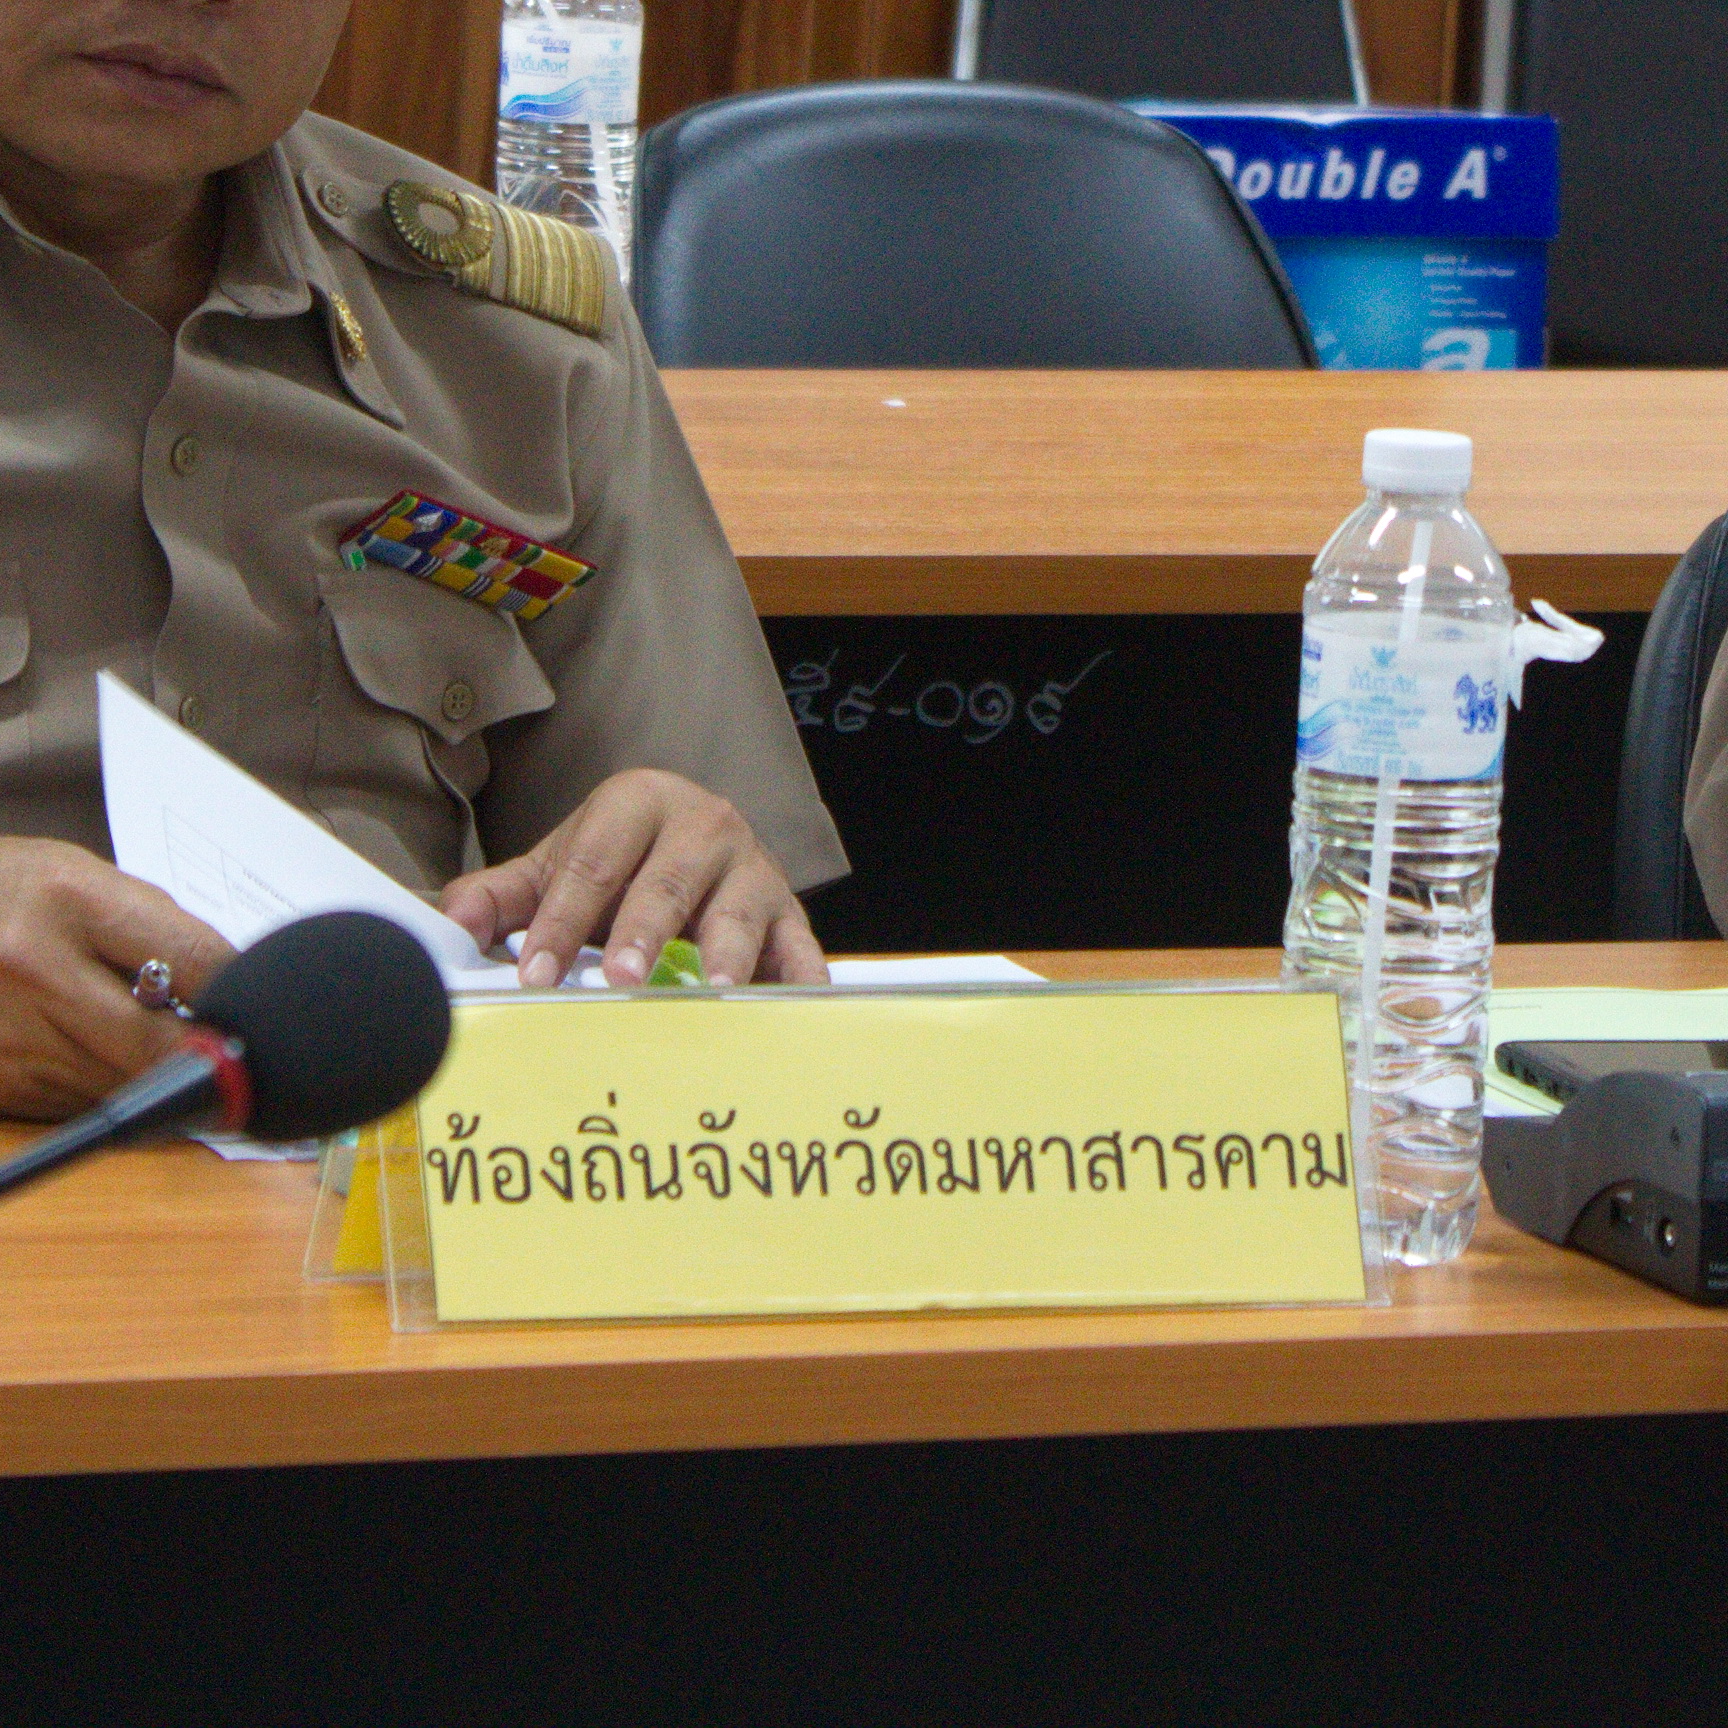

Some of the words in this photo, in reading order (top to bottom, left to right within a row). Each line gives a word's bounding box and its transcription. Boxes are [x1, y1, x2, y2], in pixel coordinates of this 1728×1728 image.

[1443, 147, 1488, 201] A
[428, 1090, 1349, 1204] ท้องถิ่นจังหวัดมหาสารคาม
